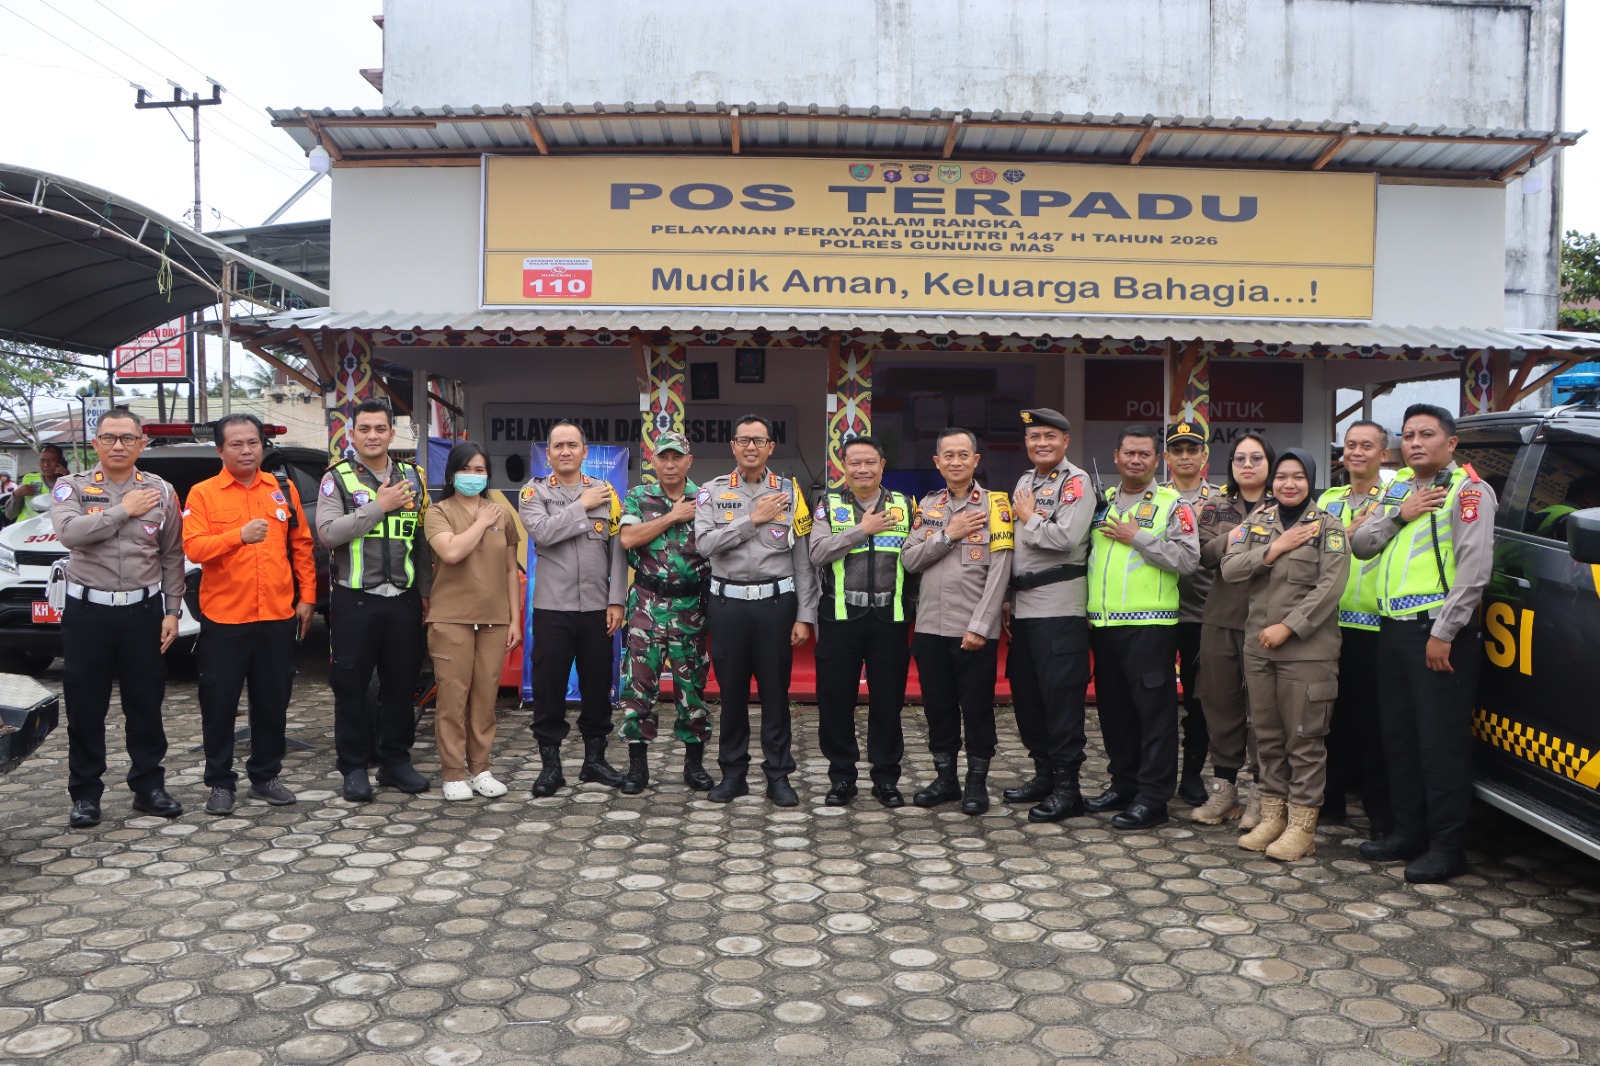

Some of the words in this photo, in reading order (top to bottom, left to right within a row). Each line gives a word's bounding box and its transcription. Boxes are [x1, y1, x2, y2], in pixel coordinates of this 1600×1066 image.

[610, 182, 795, 212] POS
[827, 184, 1258, 223] TERPADU
[853, 216, 925, 227] DALAM
[933, 218, 1022, 229] RANGKA
[651, 224, 777, 235] PELAYANAN
[784, 226, 897, 238] PERAYAAN
[904, 229, 1008, 240] IDULFITRI
[1018, 231, 1063, 241] 1447
[1071, 232, 1085, 242] H
[1094, 233, 1163, 244] TAHUN
[1172, 235, 1218, 245] 2026
[819, 238, 903, 249] POLRES
[910, 240, 1003, 251] GUNUNG
[1010, 242, 1055, 252] MAS
[529, 278, 586, 293] 110
[652, 267, 770, 292] Mudik
[782, 269, 909, 299] Aman,
[924, 272, 1100, 304] Keluarga
[1114, 276, 1318, 307] Bahagia...!
[162, 327, 178, 338] DAY
[1209, 402, 1264, 418] NTUK
[34, 604, 49, 617] KH
